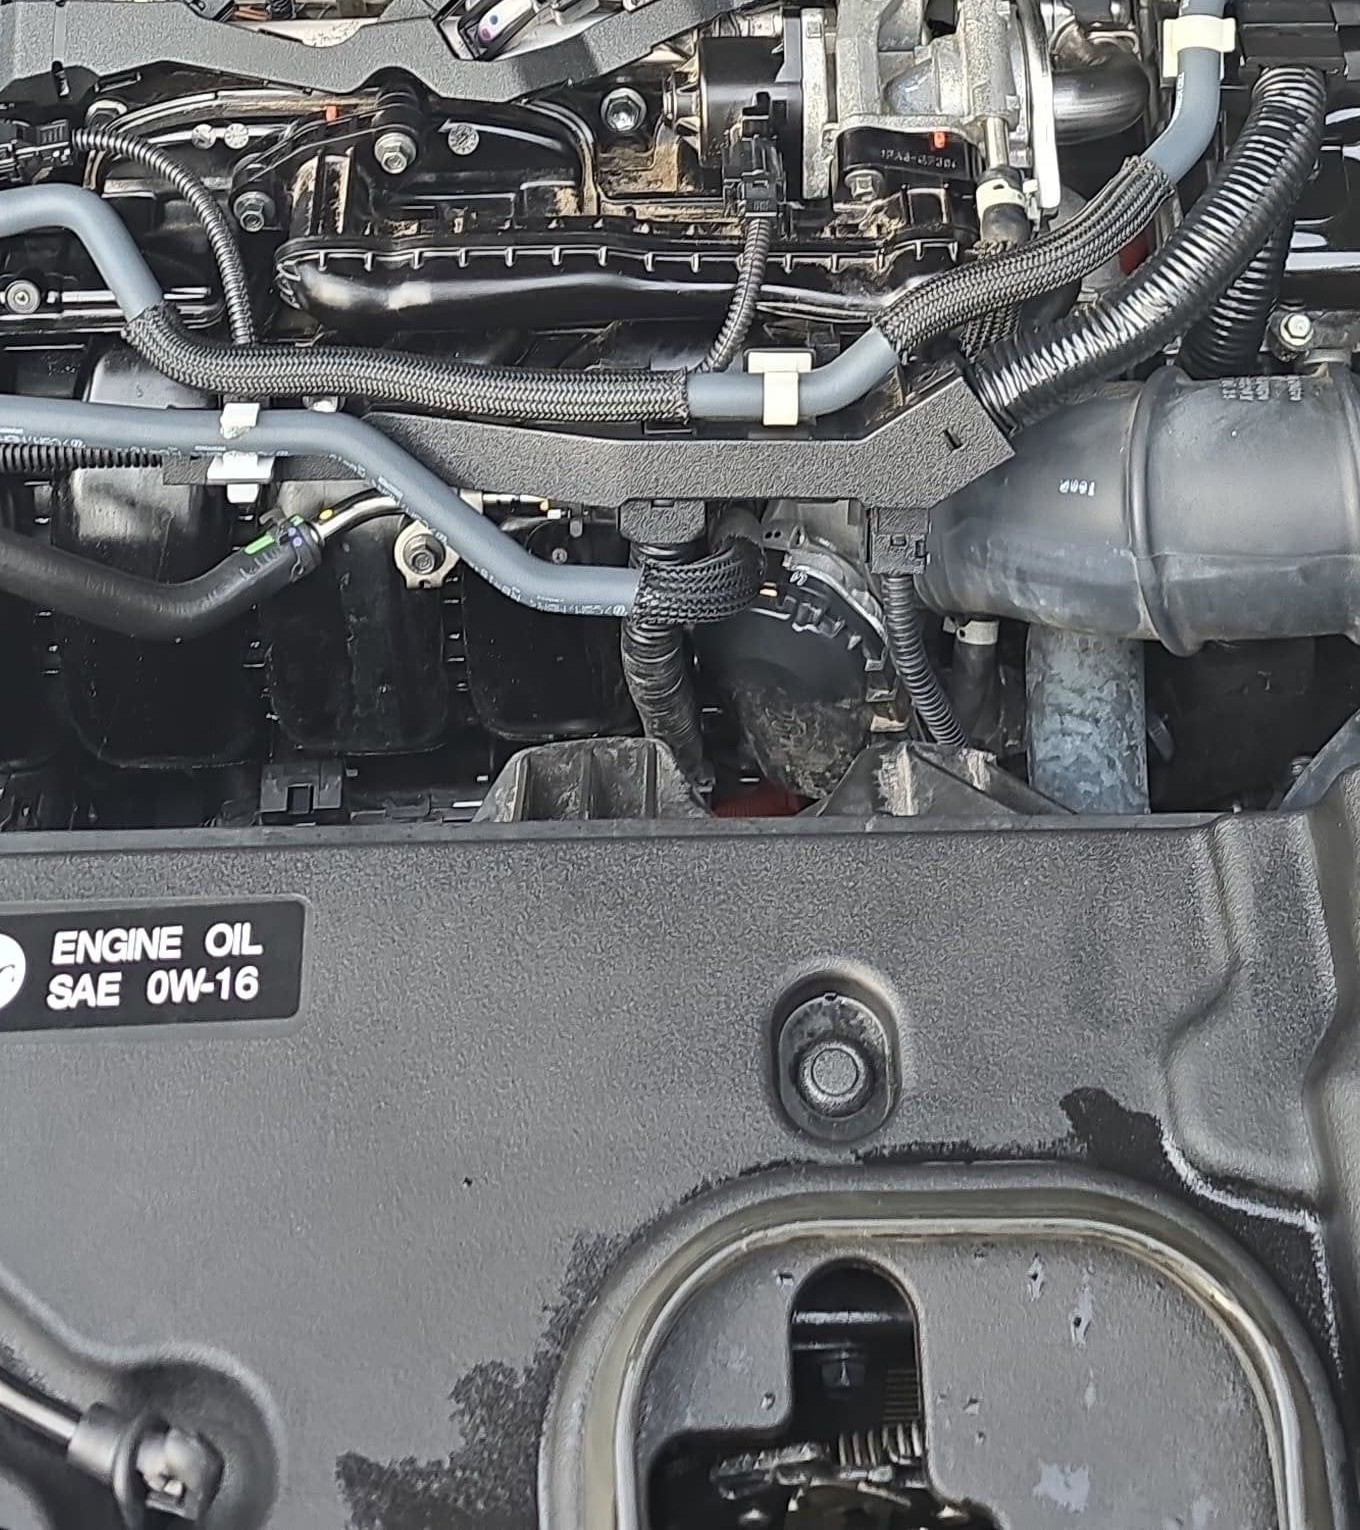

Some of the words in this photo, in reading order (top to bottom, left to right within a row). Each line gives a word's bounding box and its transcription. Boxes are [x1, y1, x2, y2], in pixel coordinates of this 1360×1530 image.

[50, 925, 184, 966] ENGINE
[204, 922, 264, 958] OIL
[45, 971, 123, 1011] SAE
[145, 965, 260, 1006] 0W-16
